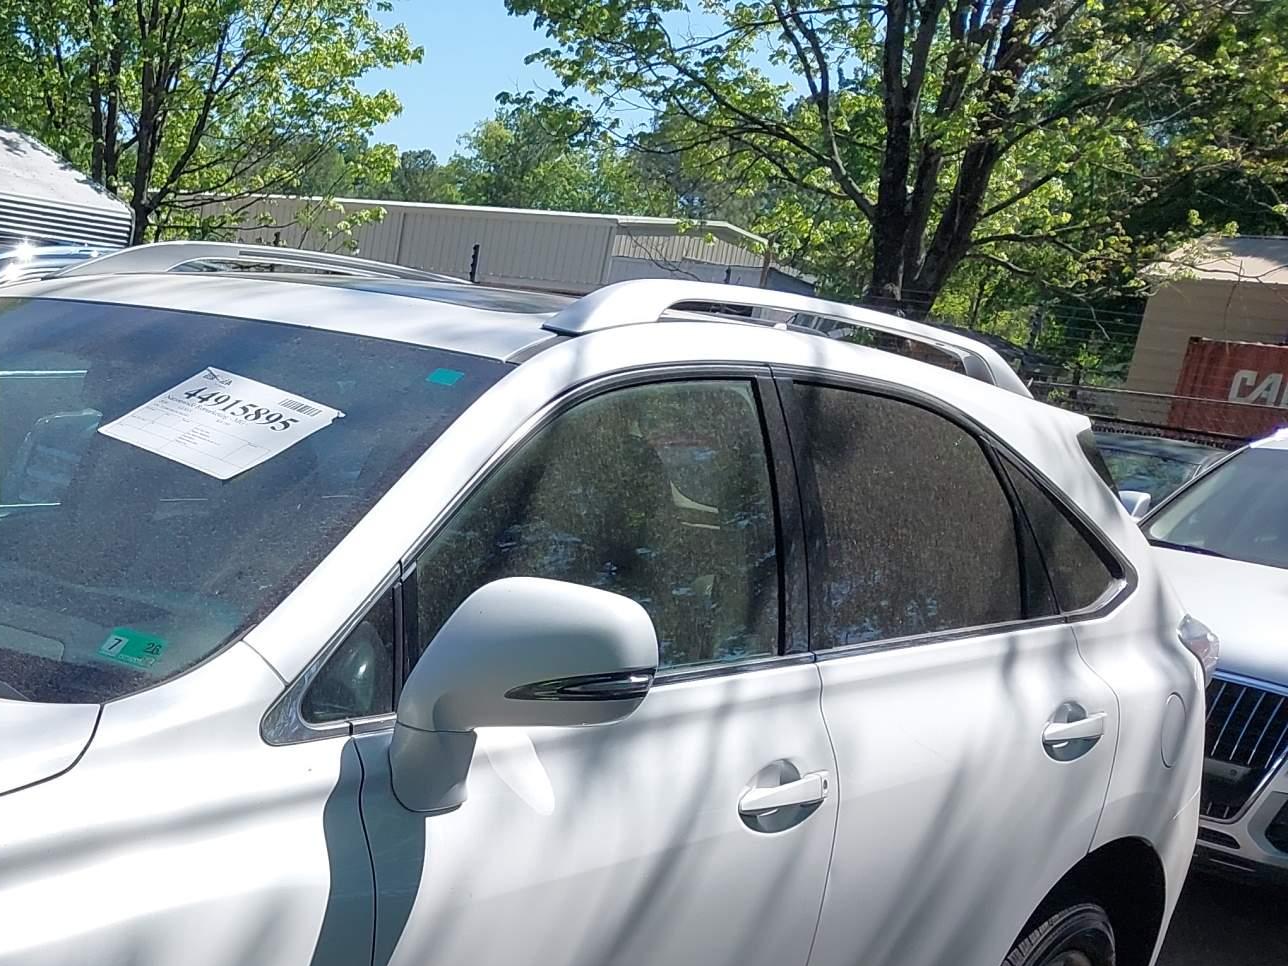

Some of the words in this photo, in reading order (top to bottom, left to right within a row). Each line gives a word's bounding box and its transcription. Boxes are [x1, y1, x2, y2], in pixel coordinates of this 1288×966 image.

[184, 386, 299, 432] 44915895
[1228, 369, 1288, 409] CA
[108, 638, 123, 651] 7
